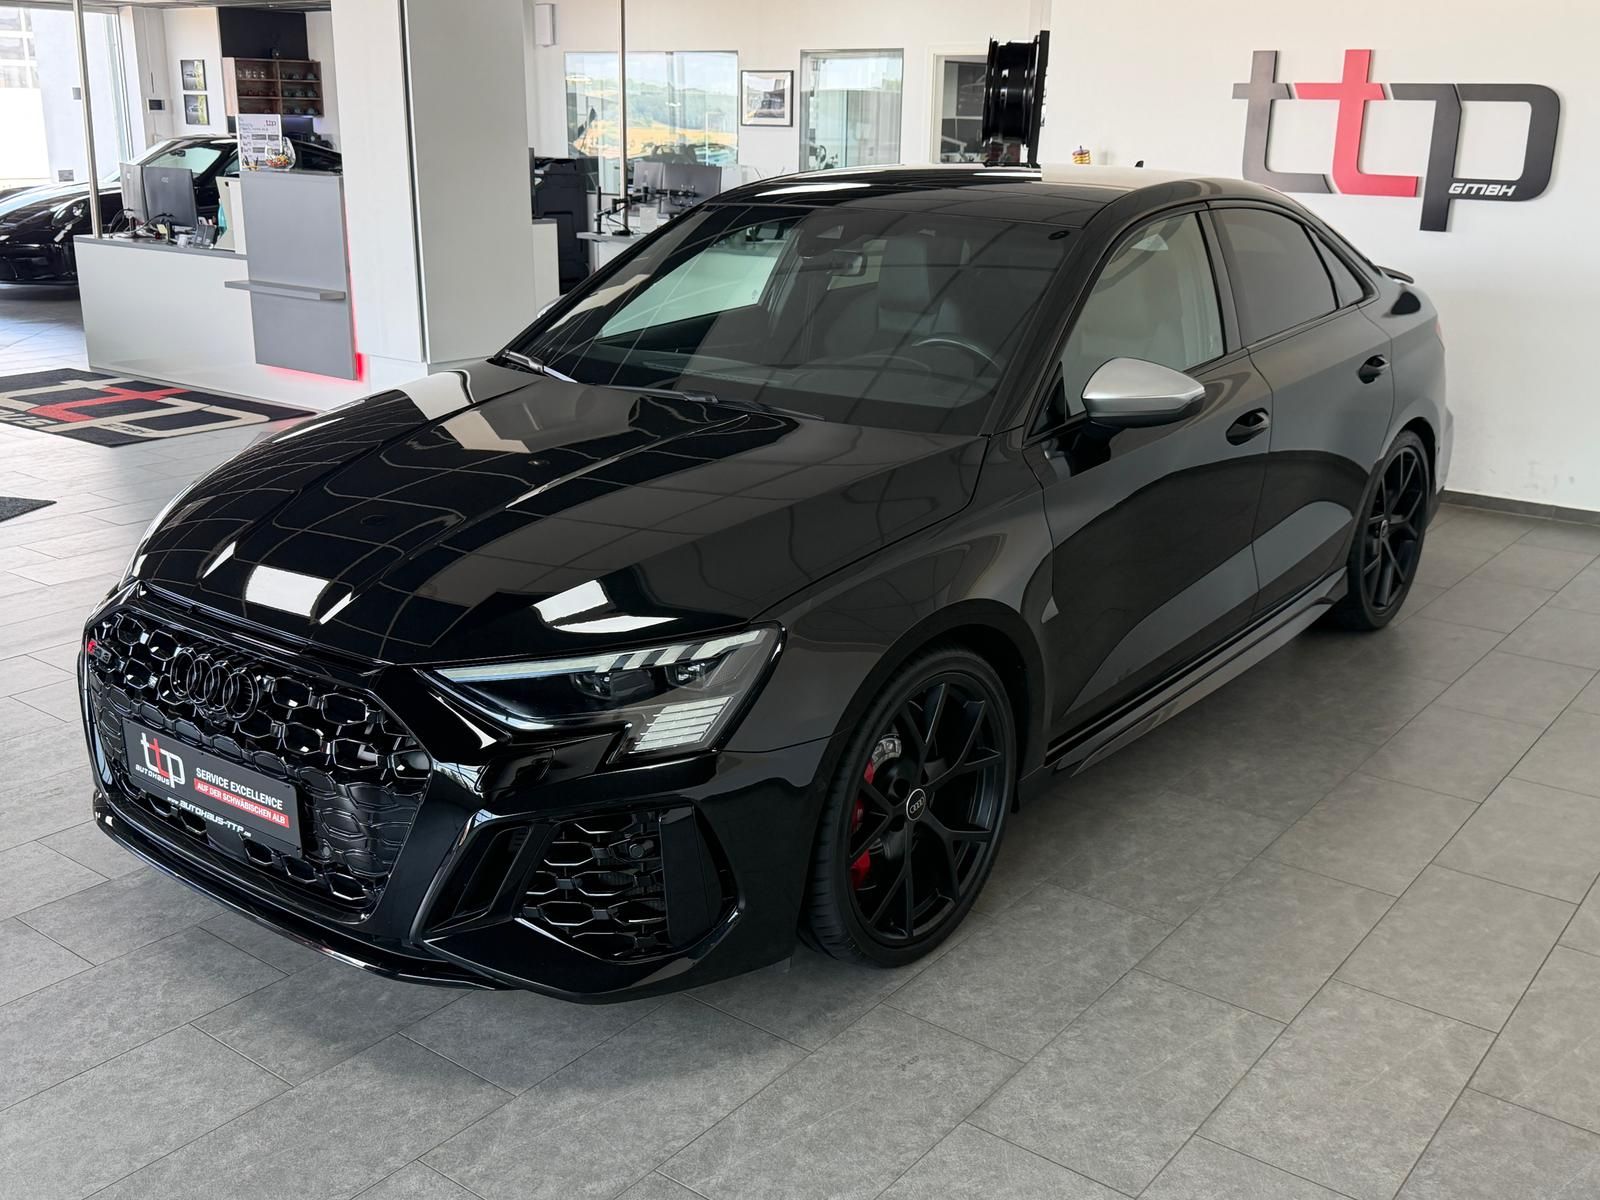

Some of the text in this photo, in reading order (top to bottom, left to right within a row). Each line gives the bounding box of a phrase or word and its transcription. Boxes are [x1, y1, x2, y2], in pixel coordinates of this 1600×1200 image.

[1232, 49, 1561, 232] ttp
[140, 732, 186, 788] ttp
[195, 767, 283, 811] SERVICE EXCELLENCE
[197, 782, 209, 793] AUF
[209, 788, 222, 799] DER
[272, 813, 286, 825] ALB
